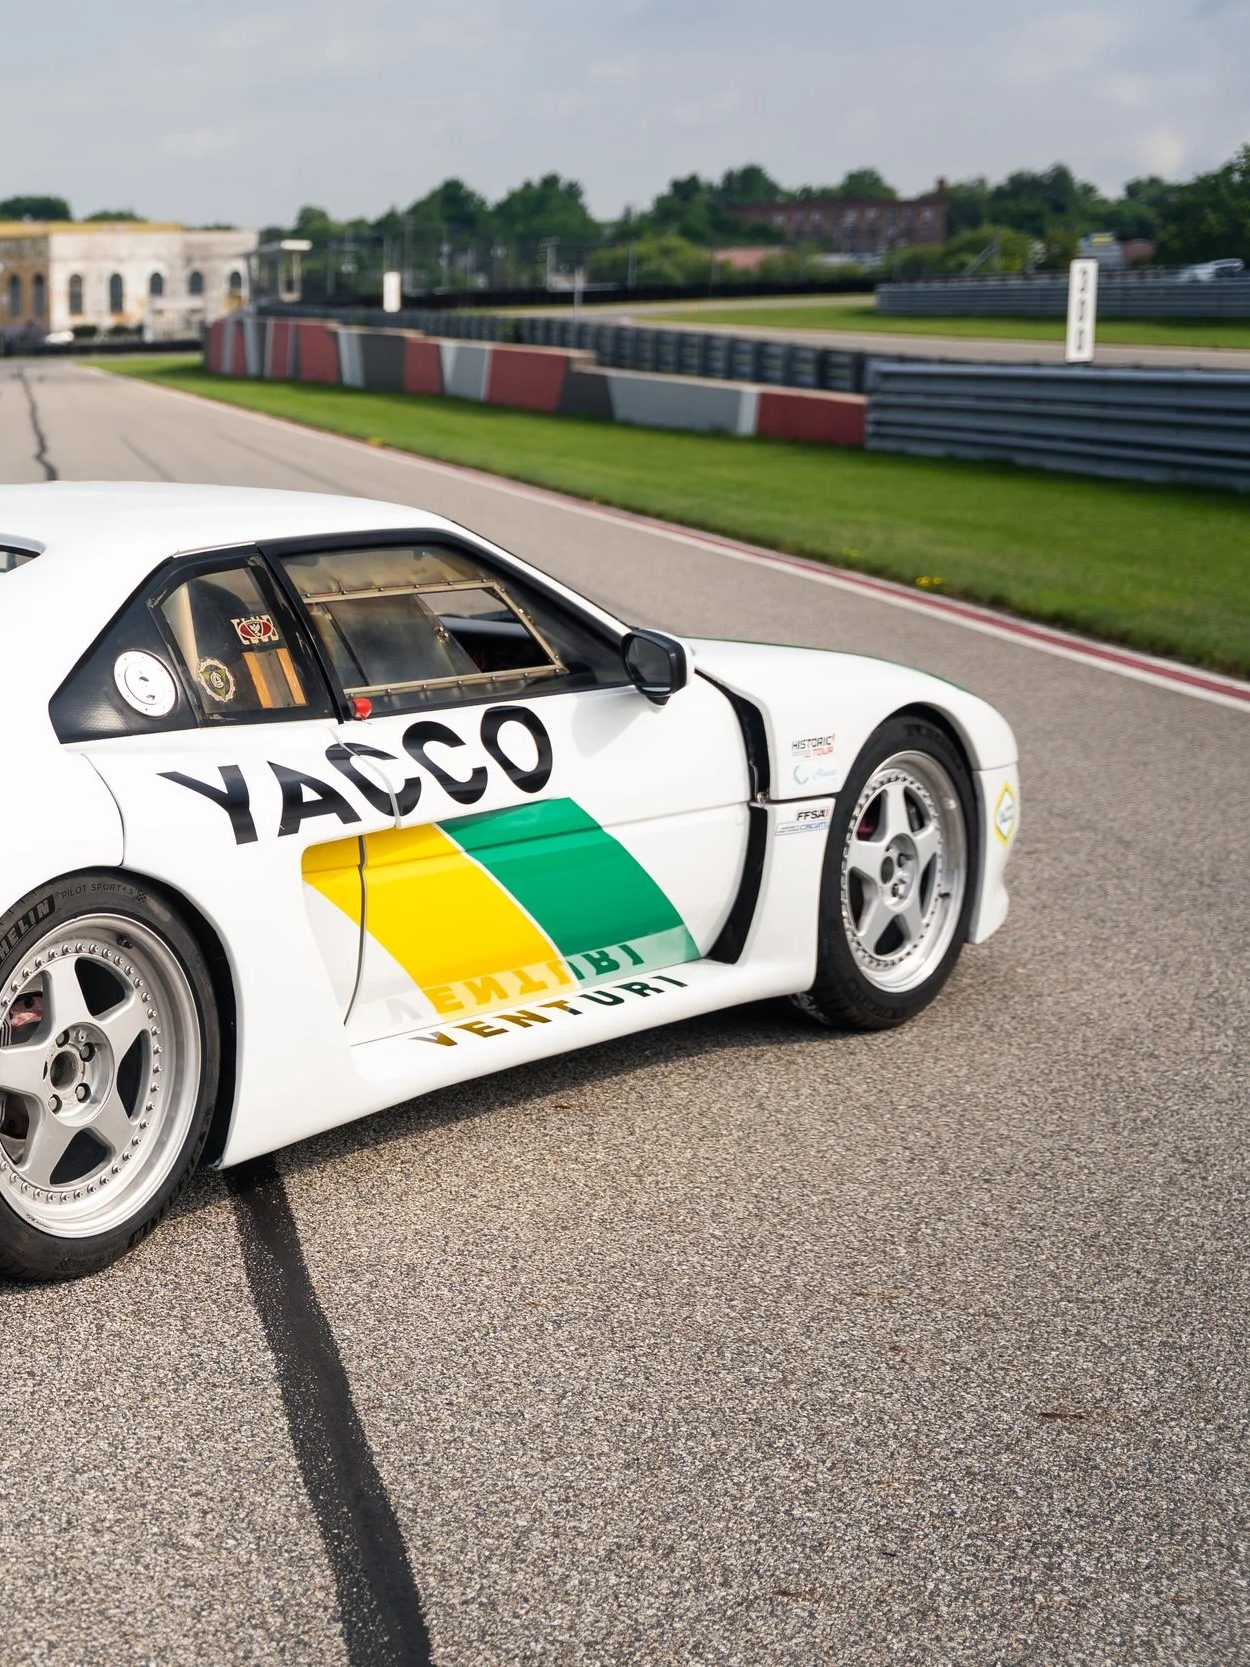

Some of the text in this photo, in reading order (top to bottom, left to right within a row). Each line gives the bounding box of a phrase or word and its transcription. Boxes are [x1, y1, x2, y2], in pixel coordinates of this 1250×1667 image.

[791, 736, 832, 751] HISTORIC
[156, 705, 553, 845] YACCO
[796, 809, 825, 821] FFSA
[61, 884, 87, 899] PILOT
[408, 975, 688, 1047] VENTURI
